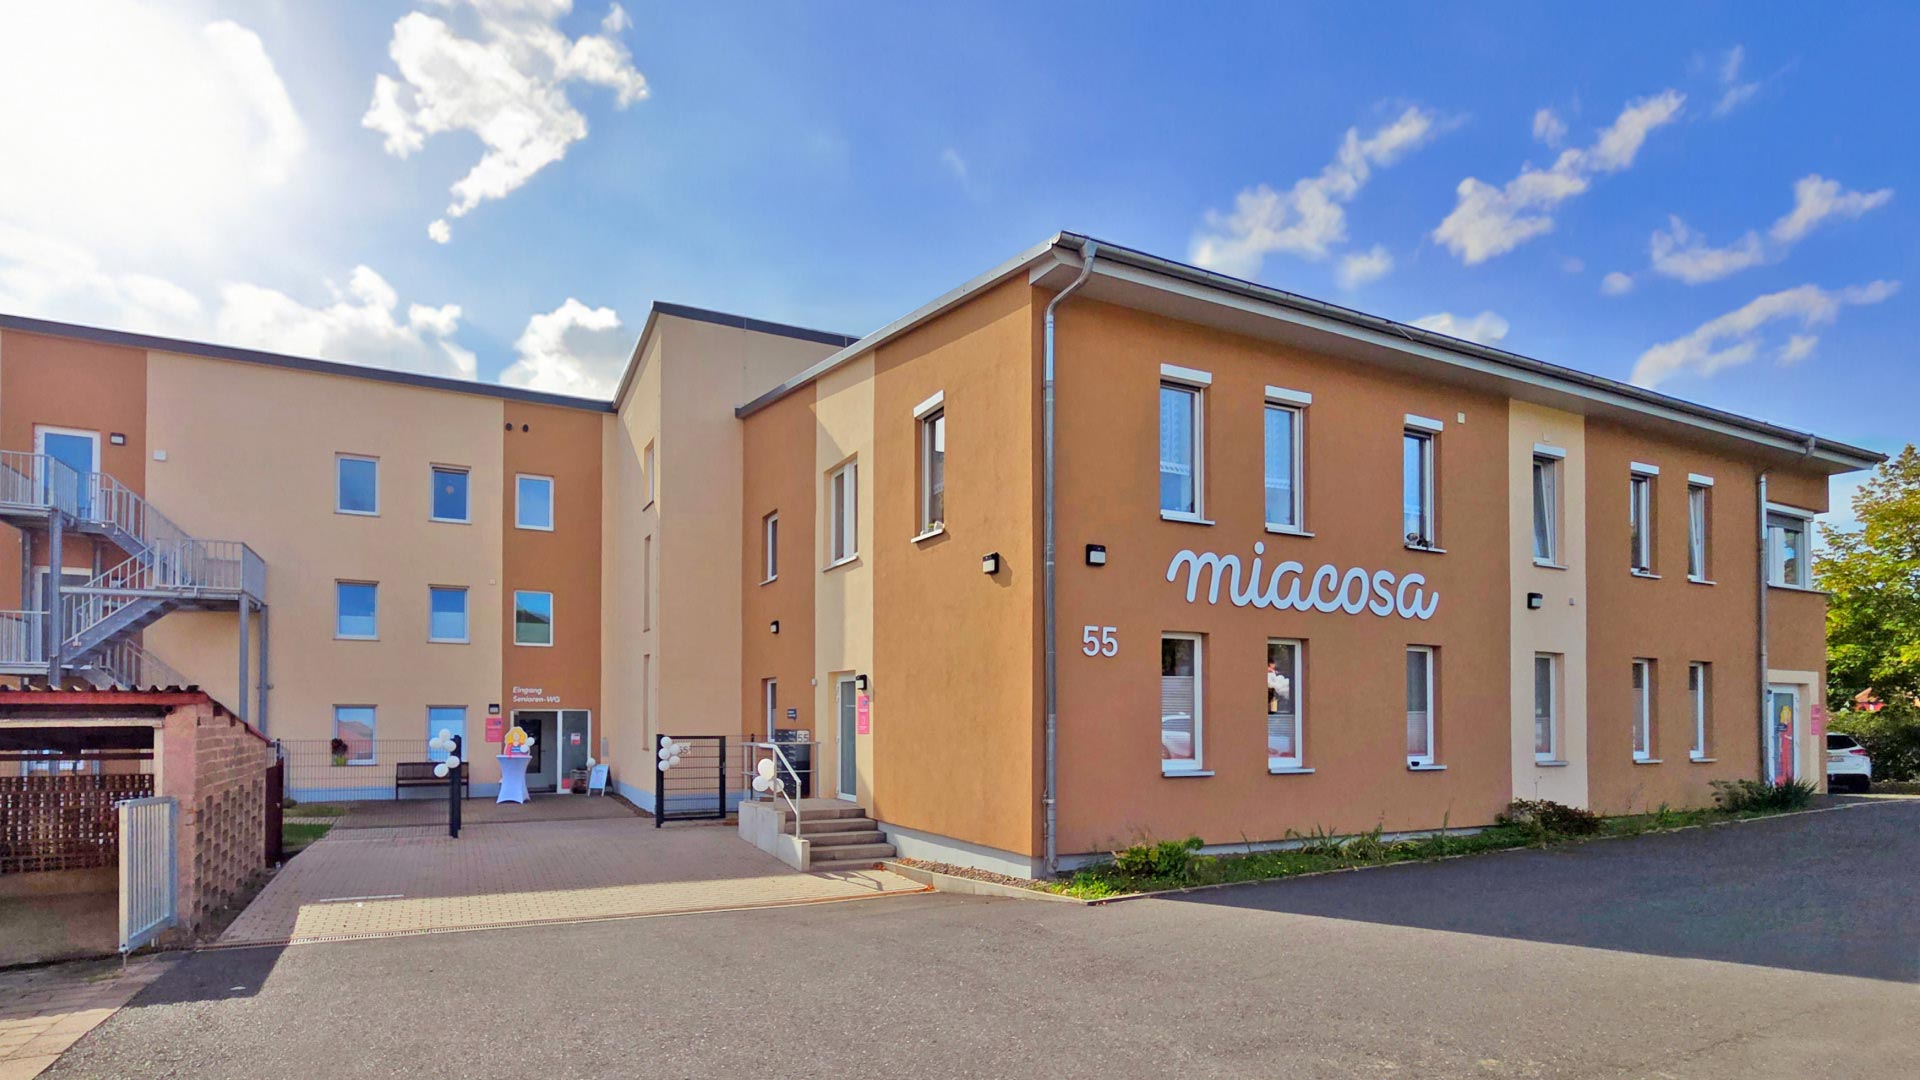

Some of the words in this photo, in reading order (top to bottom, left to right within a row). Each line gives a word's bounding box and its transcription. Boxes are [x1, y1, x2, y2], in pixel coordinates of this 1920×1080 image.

[1166, 541, 1439, 620] miacosa
[1082, 625, 1118, 657] 55
[512, 686, 542, 695] Eingang
[512, 695, 560, 703] Senioren-WG
[797, 733, 809, 742] 55
